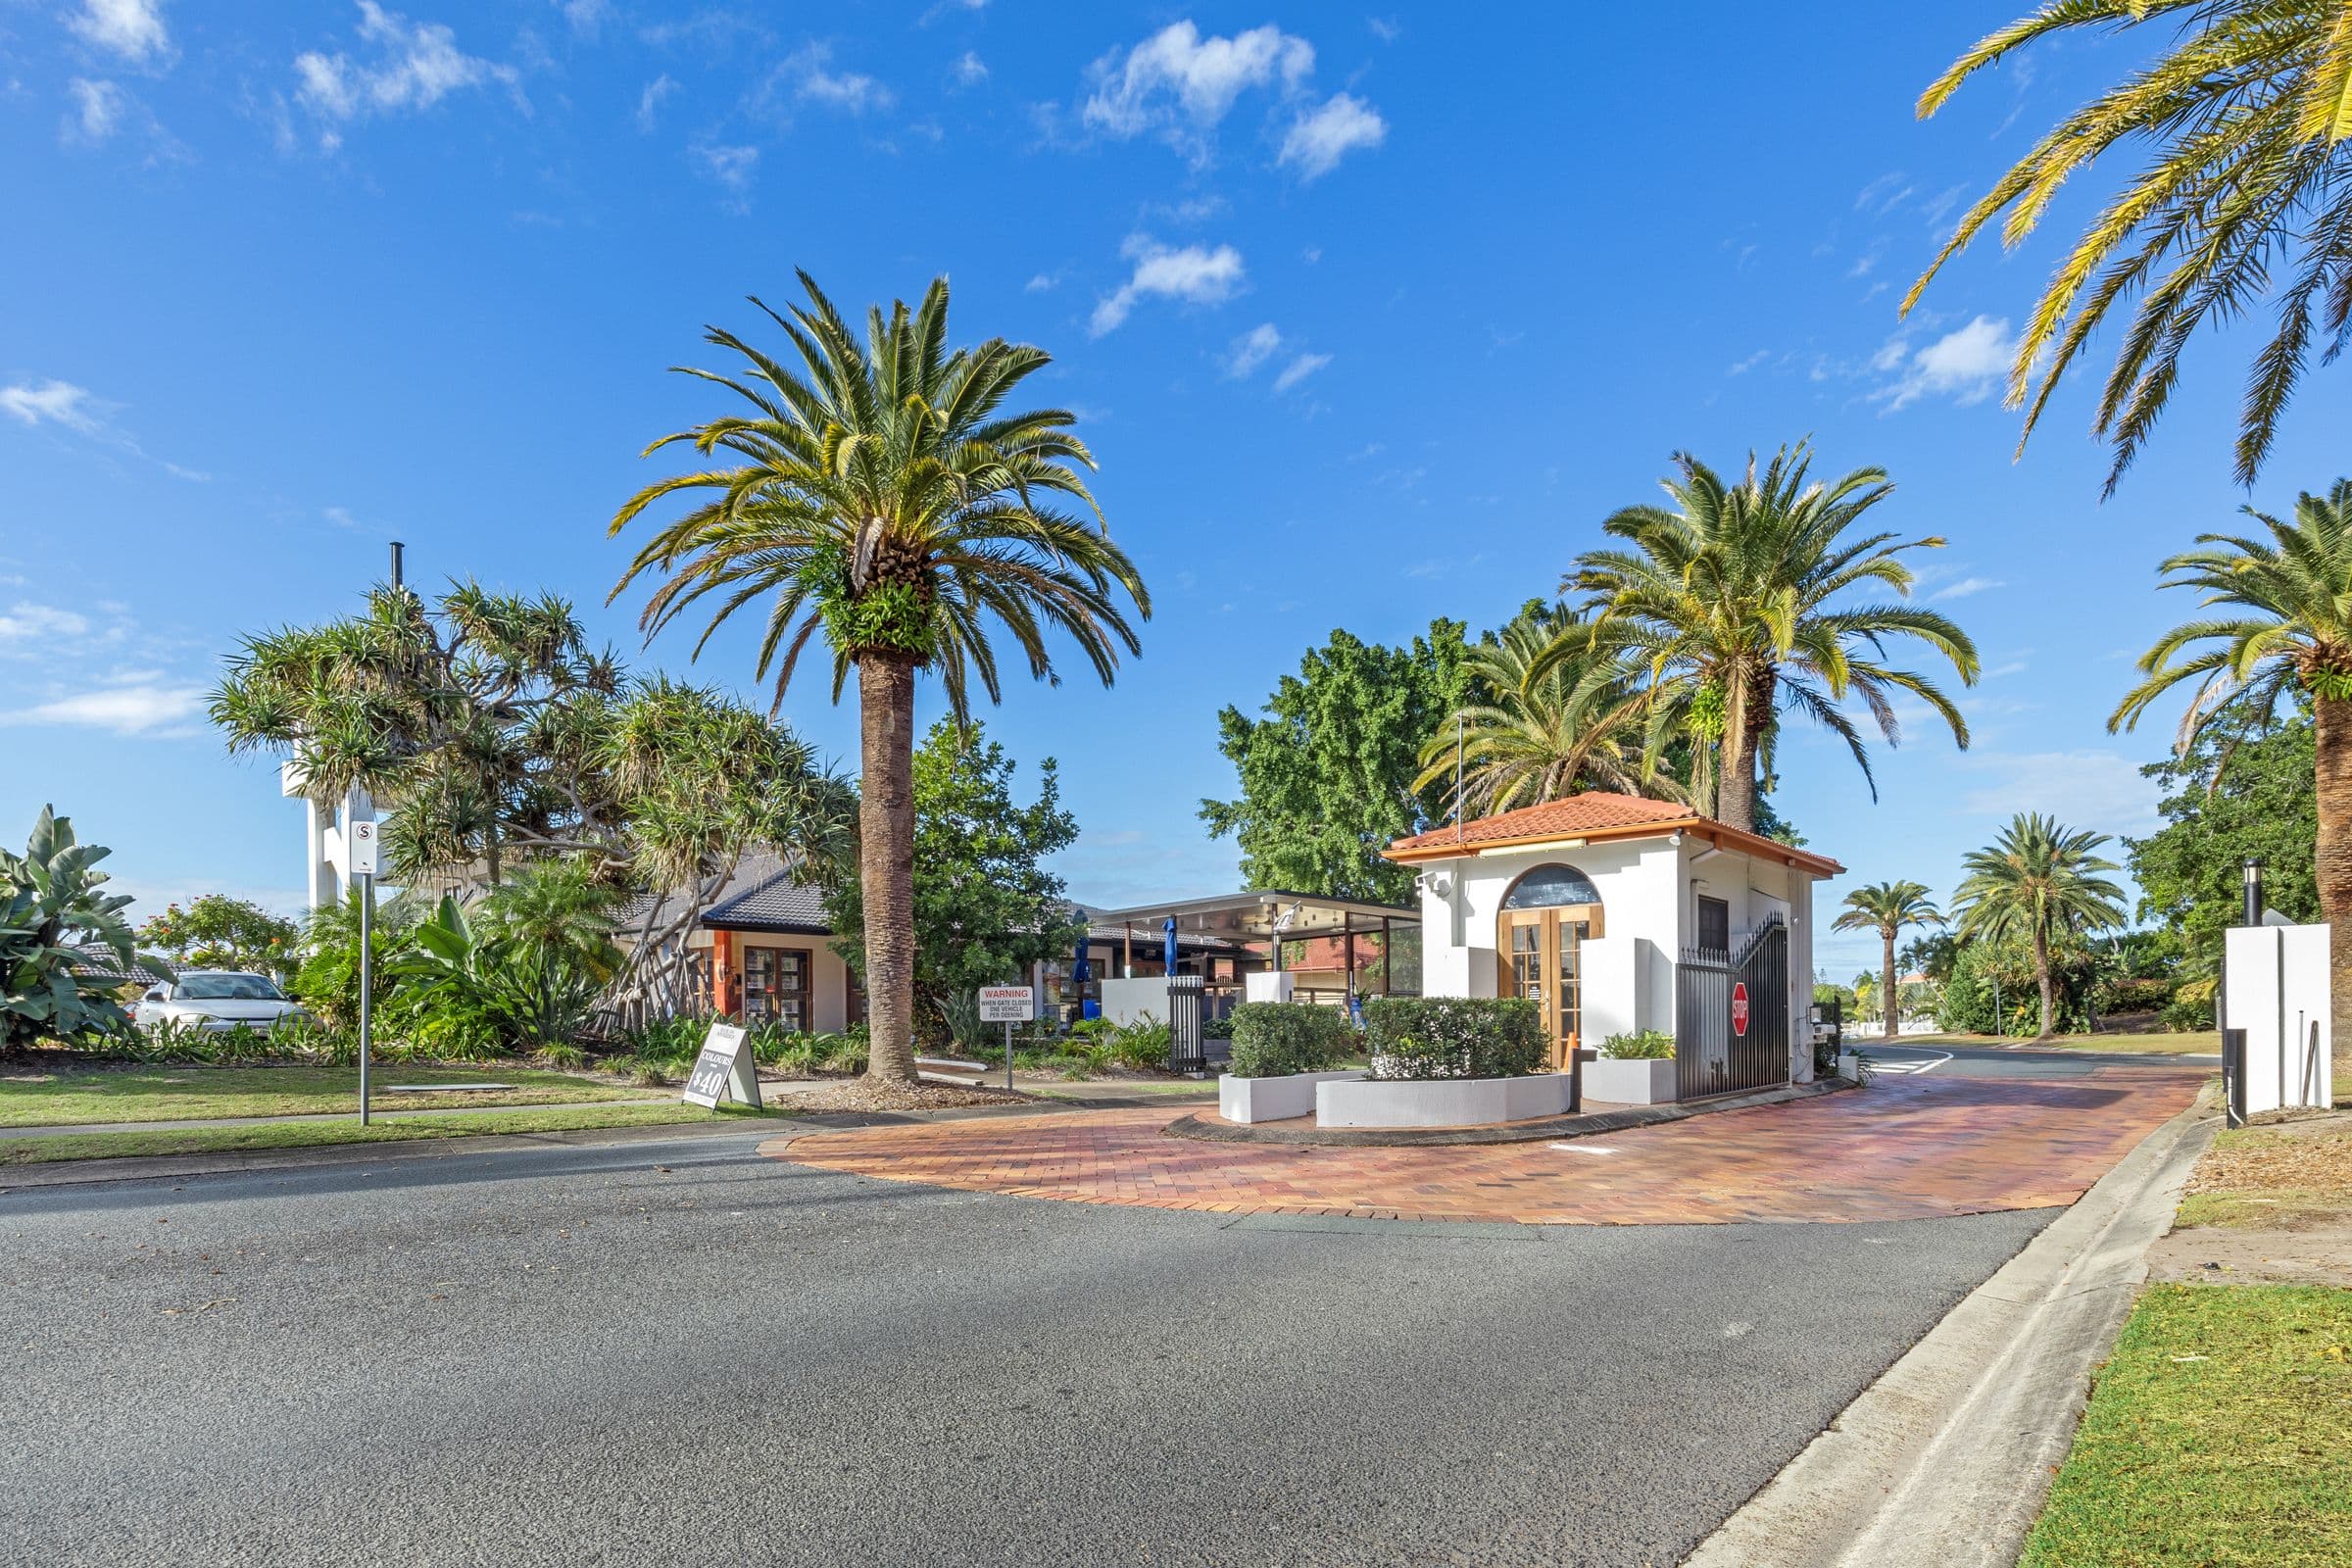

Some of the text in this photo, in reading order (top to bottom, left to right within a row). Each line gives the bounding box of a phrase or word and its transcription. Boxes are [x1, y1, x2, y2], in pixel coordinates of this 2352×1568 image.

[360, 826, 368, 837] S
[1734, 1000, 1747, 1018] STOP
[702, 1051, 732, 1066] COLOURS
[693, 1071, 722, 1096] $40
